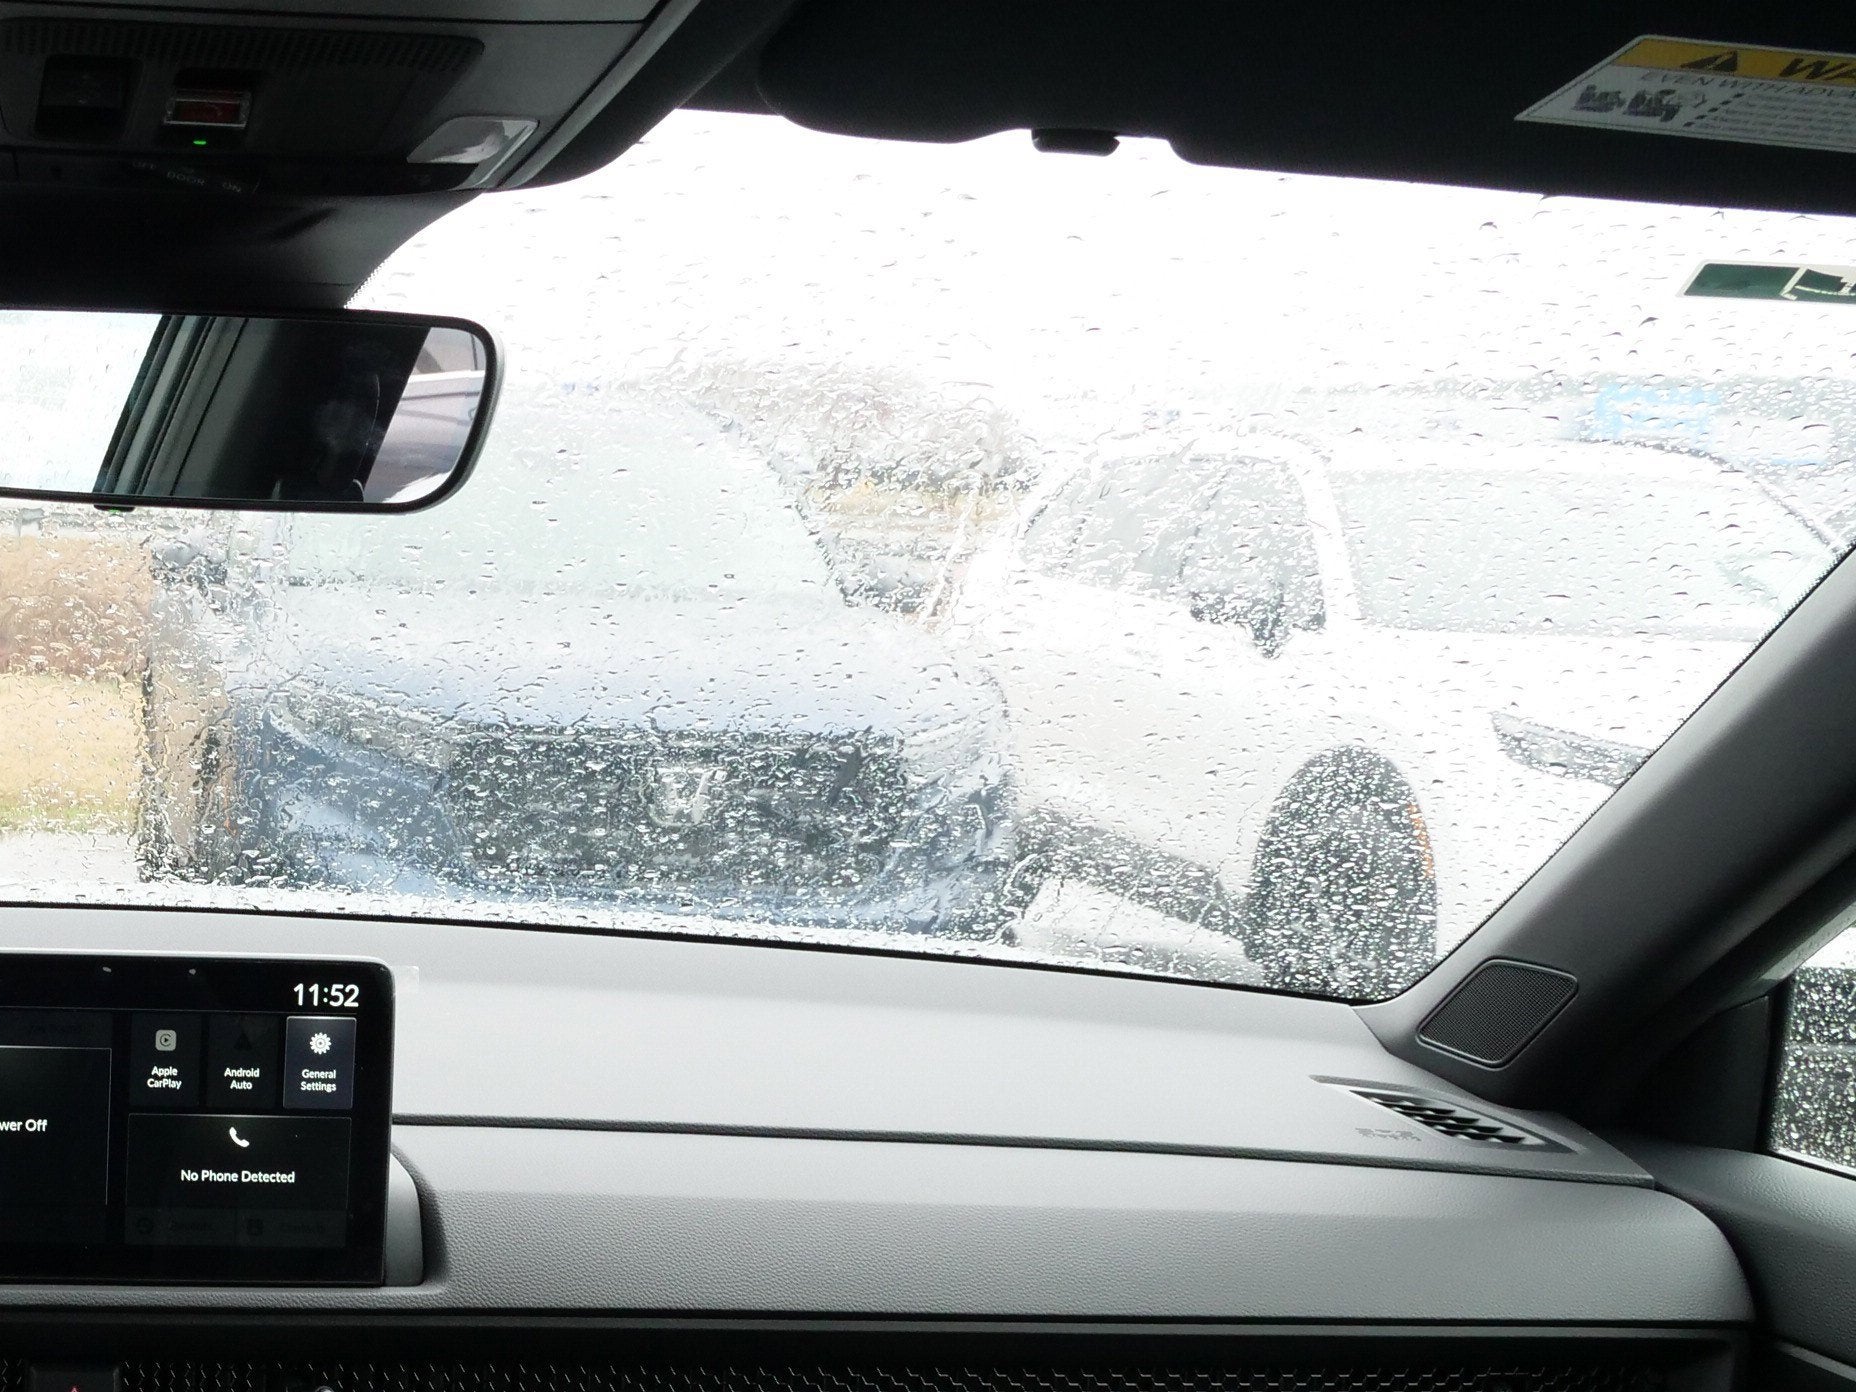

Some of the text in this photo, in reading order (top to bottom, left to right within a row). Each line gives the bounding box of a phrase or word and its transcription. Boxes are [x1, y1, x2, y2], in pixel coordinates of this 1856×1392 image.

[293, 983, 360, 1007] 11:52
[151, 1066, 178, 1078] Apple
[224, 1067, 260, 1078] Android
[301, 1068, 336, 1079] General
[147, 1078, 182, 1090] CarPlay
[230, 1079, 252, 1090] Auto
[300, 1081, 337, 1093] Settings
[25, 1118, 48, 1132] Off
[180, 1169, 296, 1184] No Phone Detected
